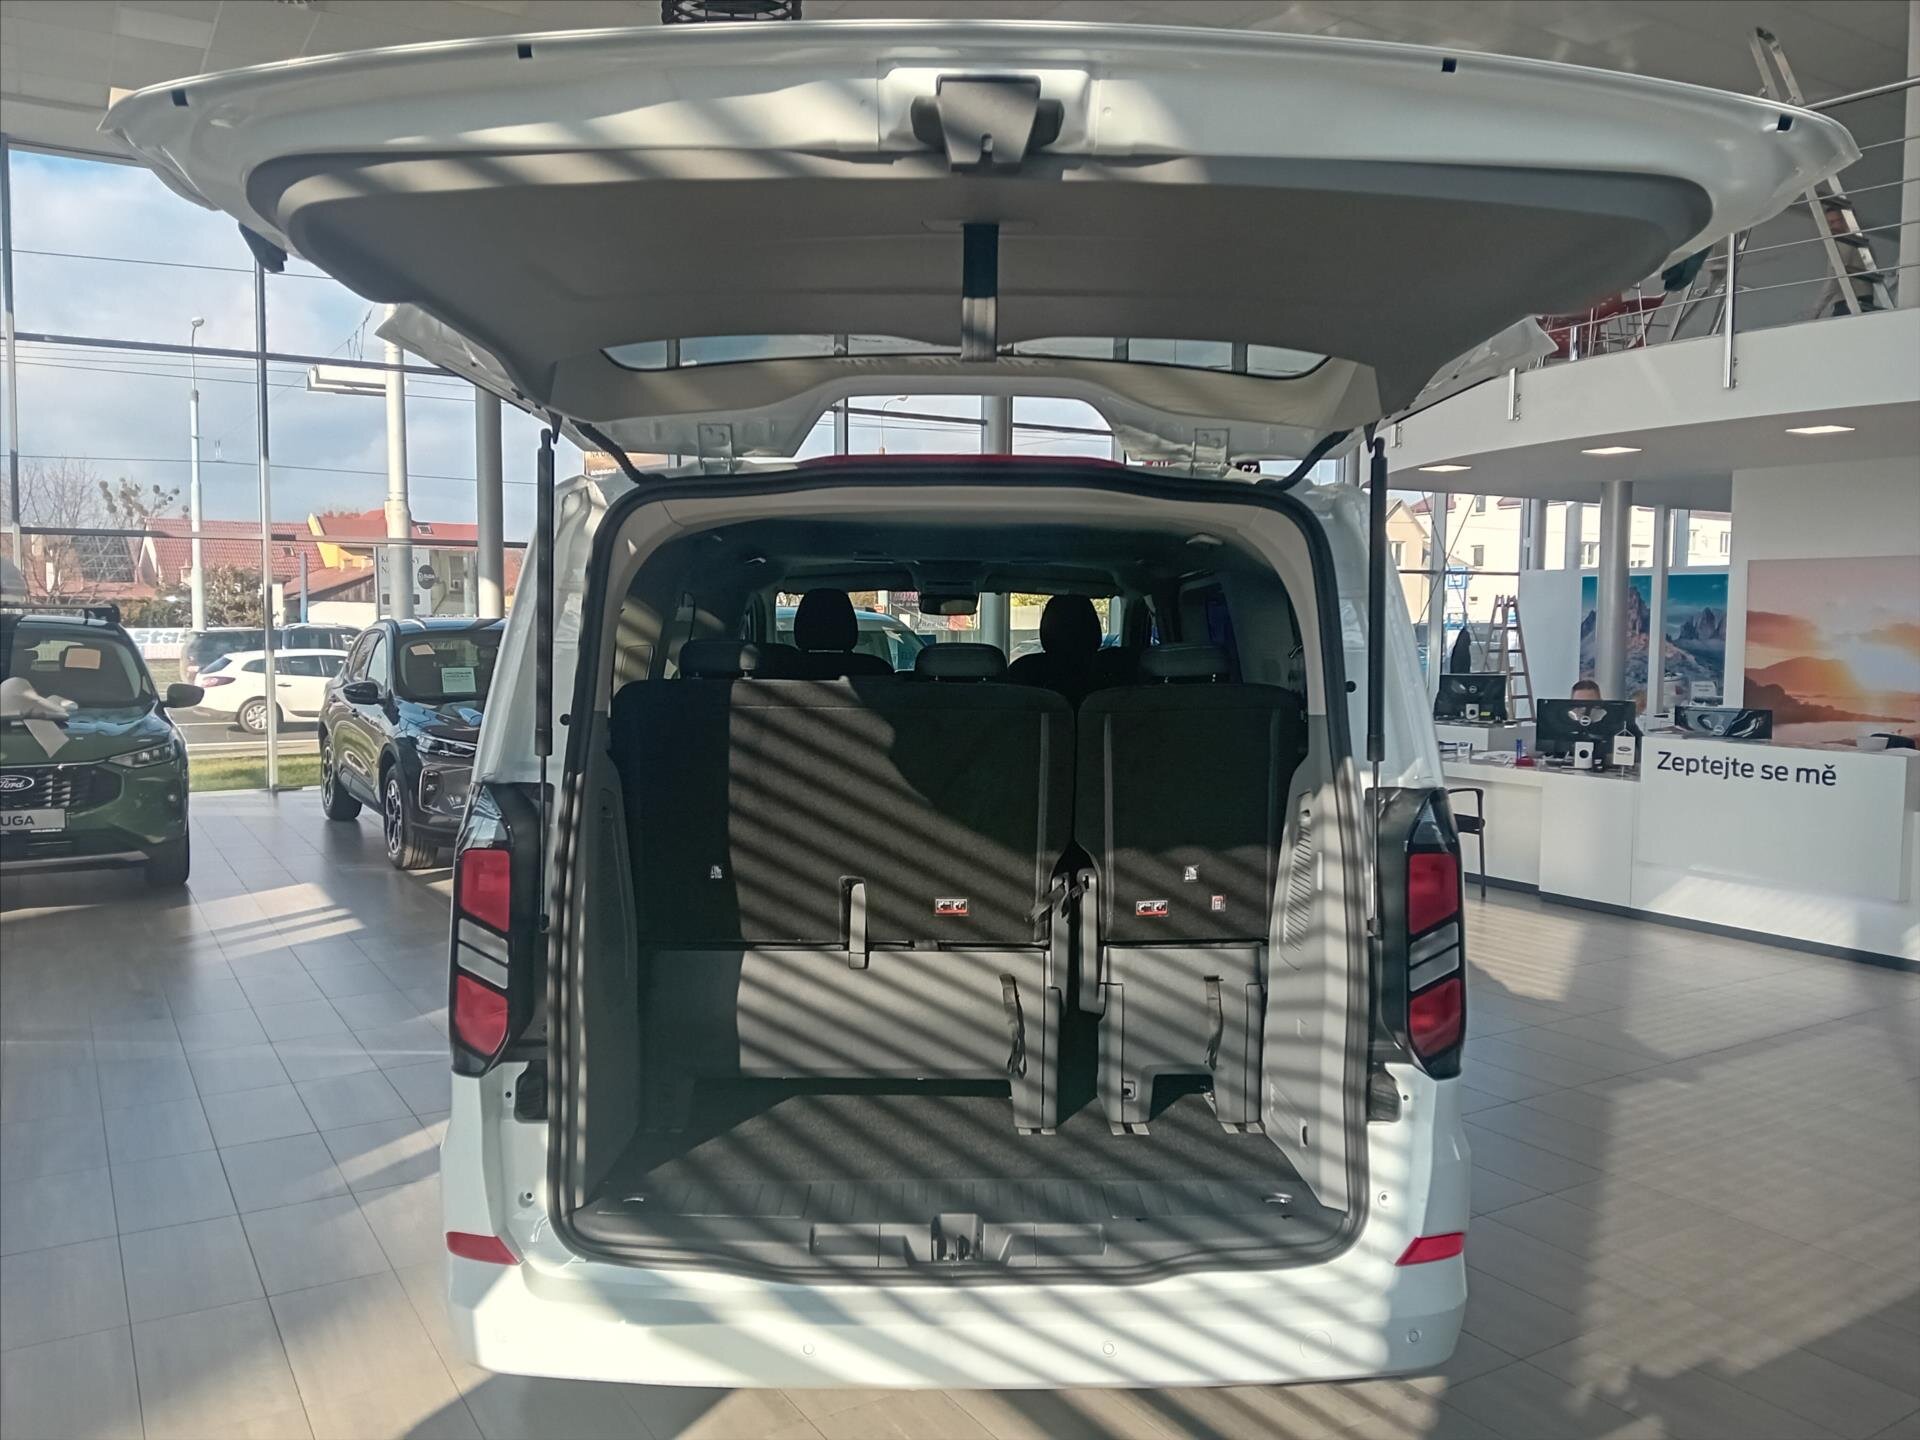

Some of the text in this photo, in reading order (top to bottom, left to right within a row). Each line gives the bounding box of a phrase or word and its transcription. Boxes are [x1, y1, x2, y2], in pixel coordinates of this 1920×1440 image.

[1657, 751, 1837, 786] Zeptejte se mě
